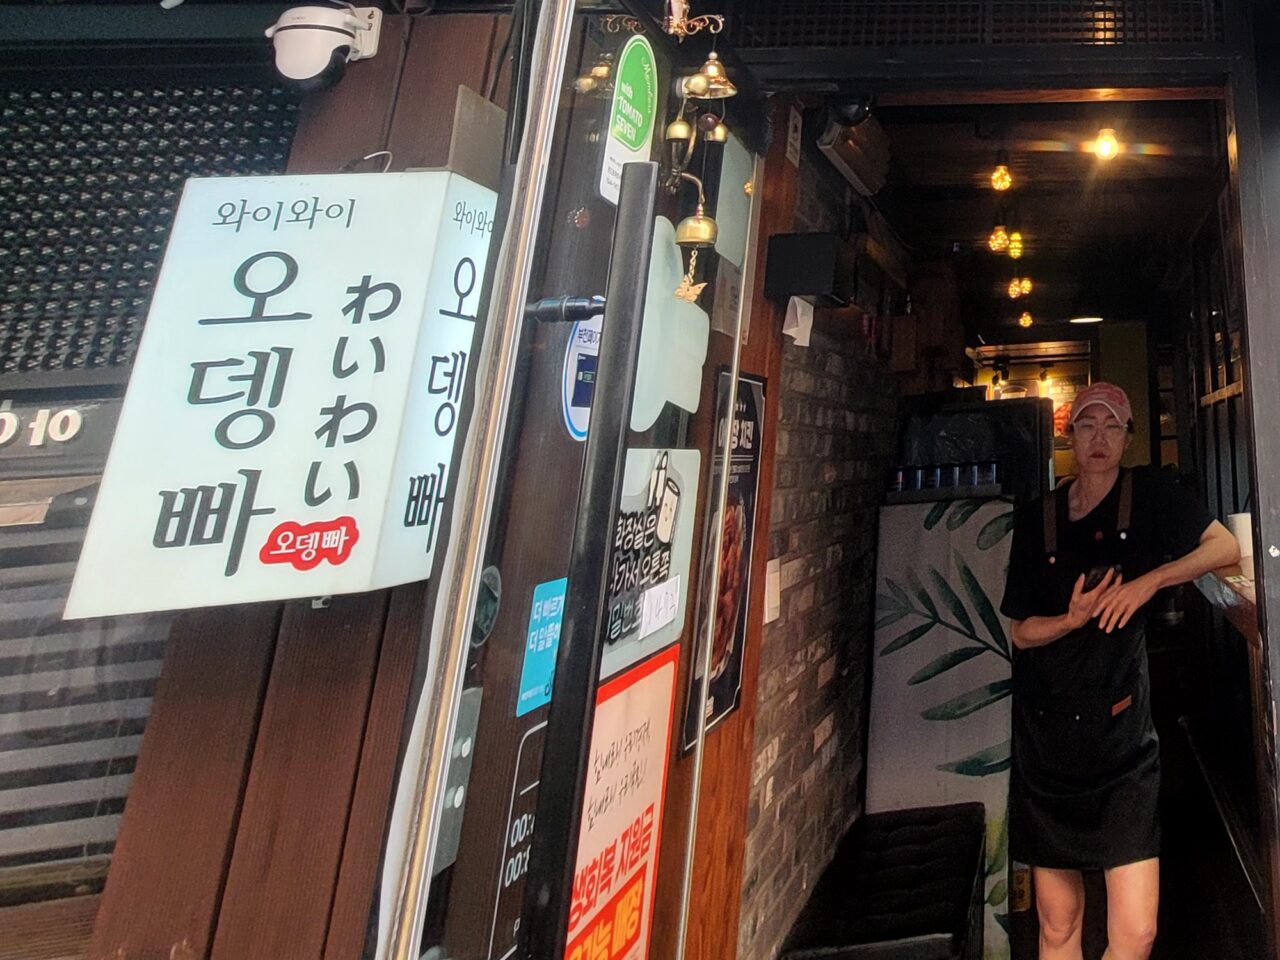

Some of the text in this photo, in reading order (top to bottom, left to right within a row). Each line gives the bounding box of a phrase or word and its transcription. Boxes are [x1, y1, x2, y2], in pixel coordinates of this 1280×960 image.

[615, 114, 637, 142] SEVEN
[618, 97, 643, 128] TOMATO
[211, 196, 356, 234] 와이와이
[304, 275, 402, 508] わいわい
[267, 528, 350, 566] 오뎅빠
[615, 803, 655, 882] 지원금
